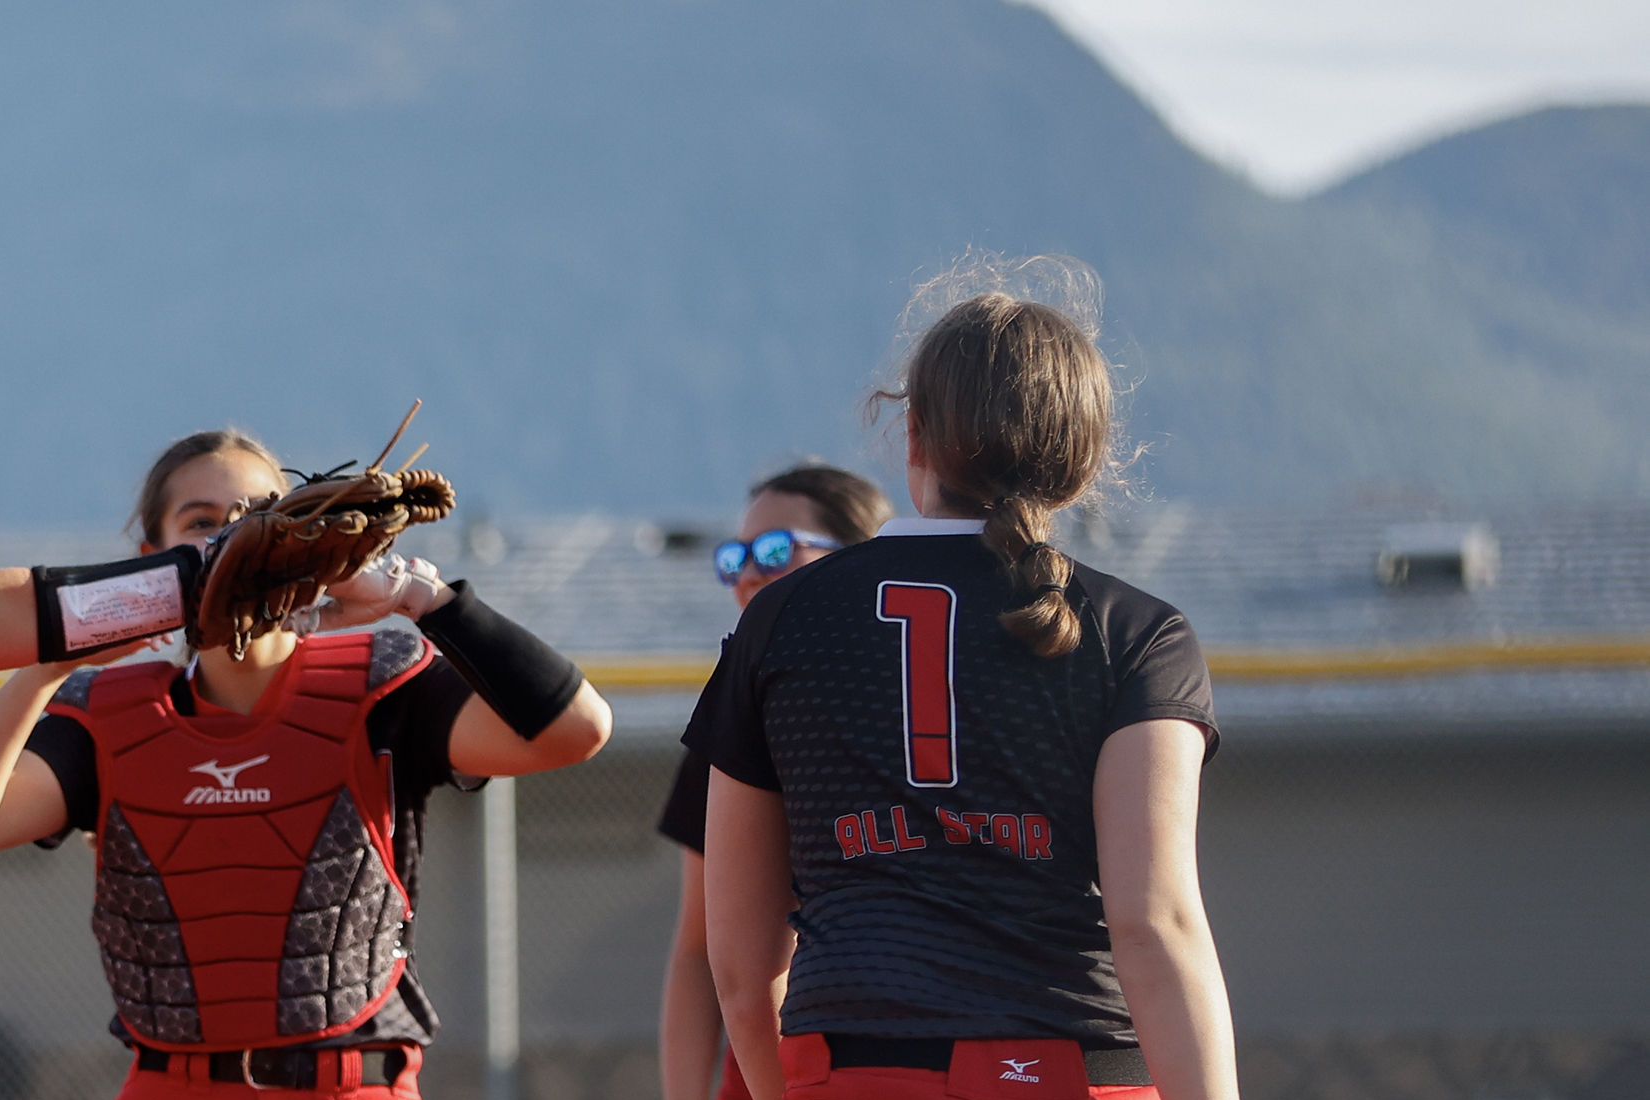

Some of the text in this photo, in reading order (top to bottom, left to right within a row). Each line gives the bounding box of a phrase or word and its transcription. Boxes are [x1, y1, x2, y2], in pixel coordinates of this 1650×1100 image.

[876, 579, 959, 788] 1
[182, 785, 272, 805] MIZUNO
[834, 805, 1054, 860] ALL STAR
[999, 1070, 1040, 1083] MIZUNO
